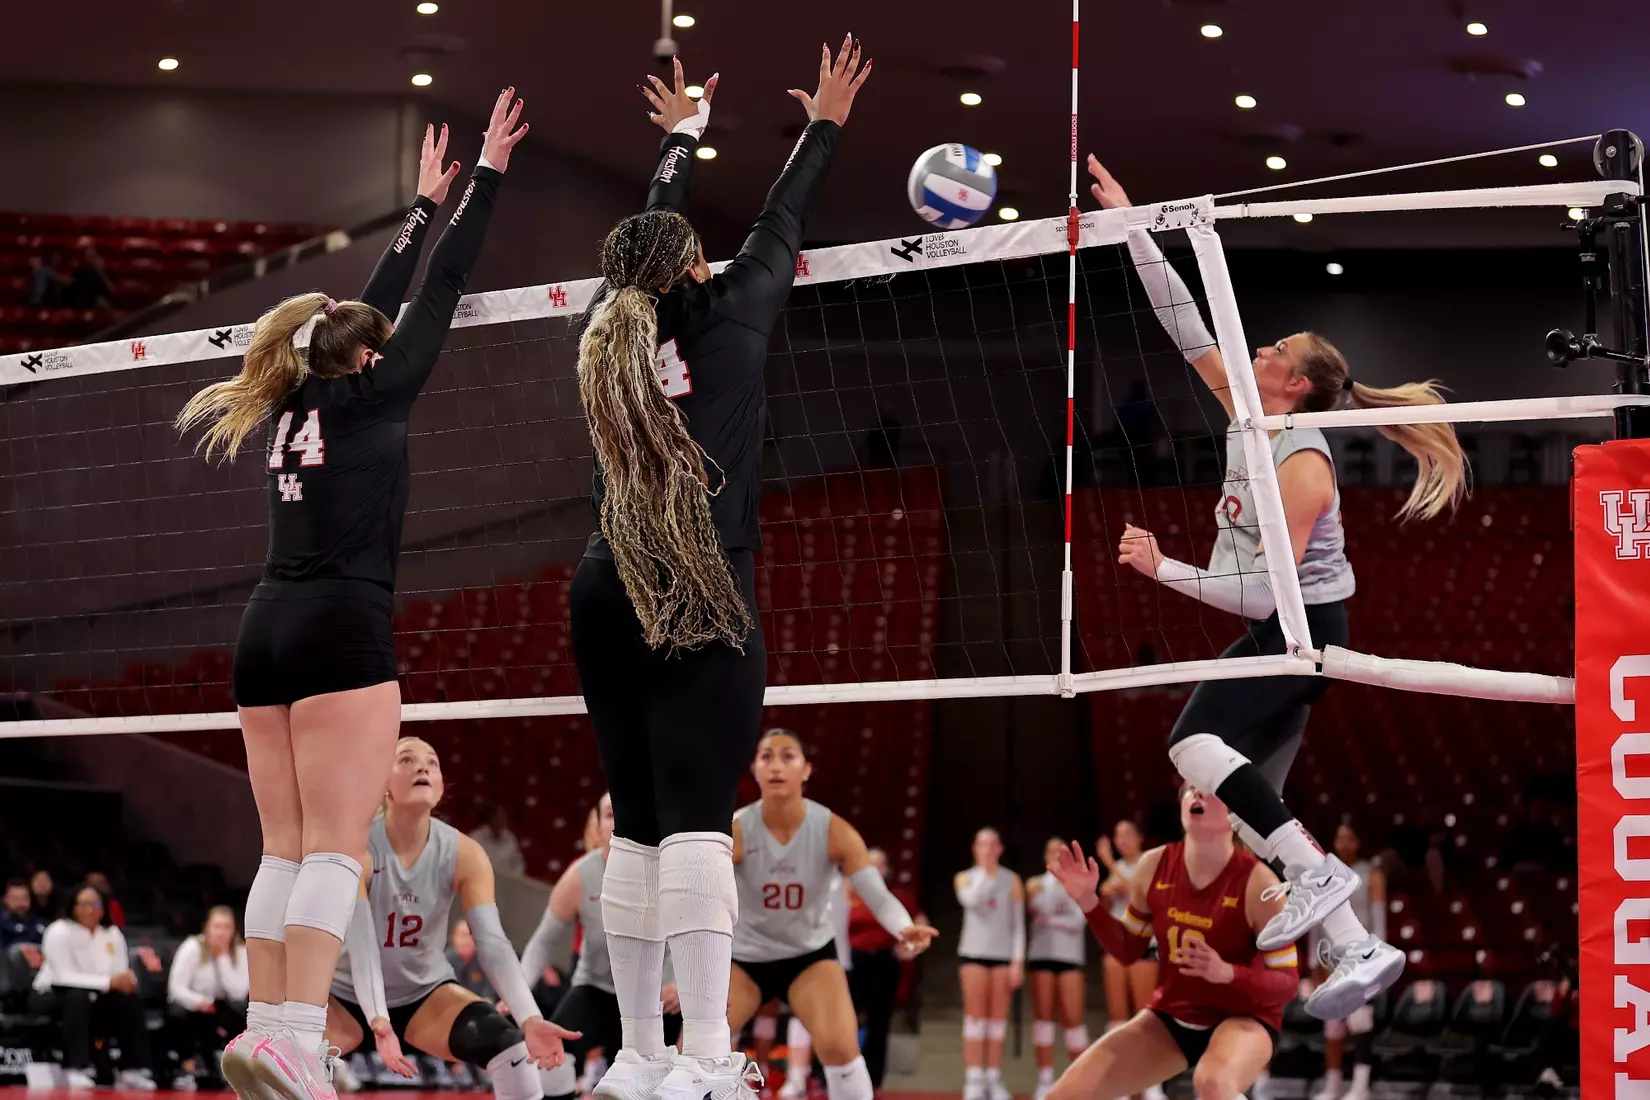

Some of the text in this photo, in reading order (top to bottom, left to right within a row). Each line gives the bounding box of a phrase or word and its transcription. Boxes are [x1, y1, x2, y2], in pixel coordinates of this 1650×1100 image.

[660, 145, 689, 184] Houston
[450, 178, 477, 226] Houston
[1168, 202, 1195, 213] Senoh
[393, 207, 428, 254] Houston
[925, 239, 959, 251] HOUSTON
[926, 247, 967, 259] VOLLEYBALL
[455, 303, 472, 312] STON
[547, 286, 568, 308] UH
[452, 310, 479, 320] LEYBALL
[234, 331, 256, 340] HOUSTO
[44, 355, 69, 364] HOUSTON
[44, 362, 73, 371] VOLLEYBALL
[267, 408, 326, 469] 14
[277, 472, 304, 503] UH
[1608, 653, 1650, 1100] COUGA
[763, 883, 805, 911] 20
[383, 911, 424, 948] 12
